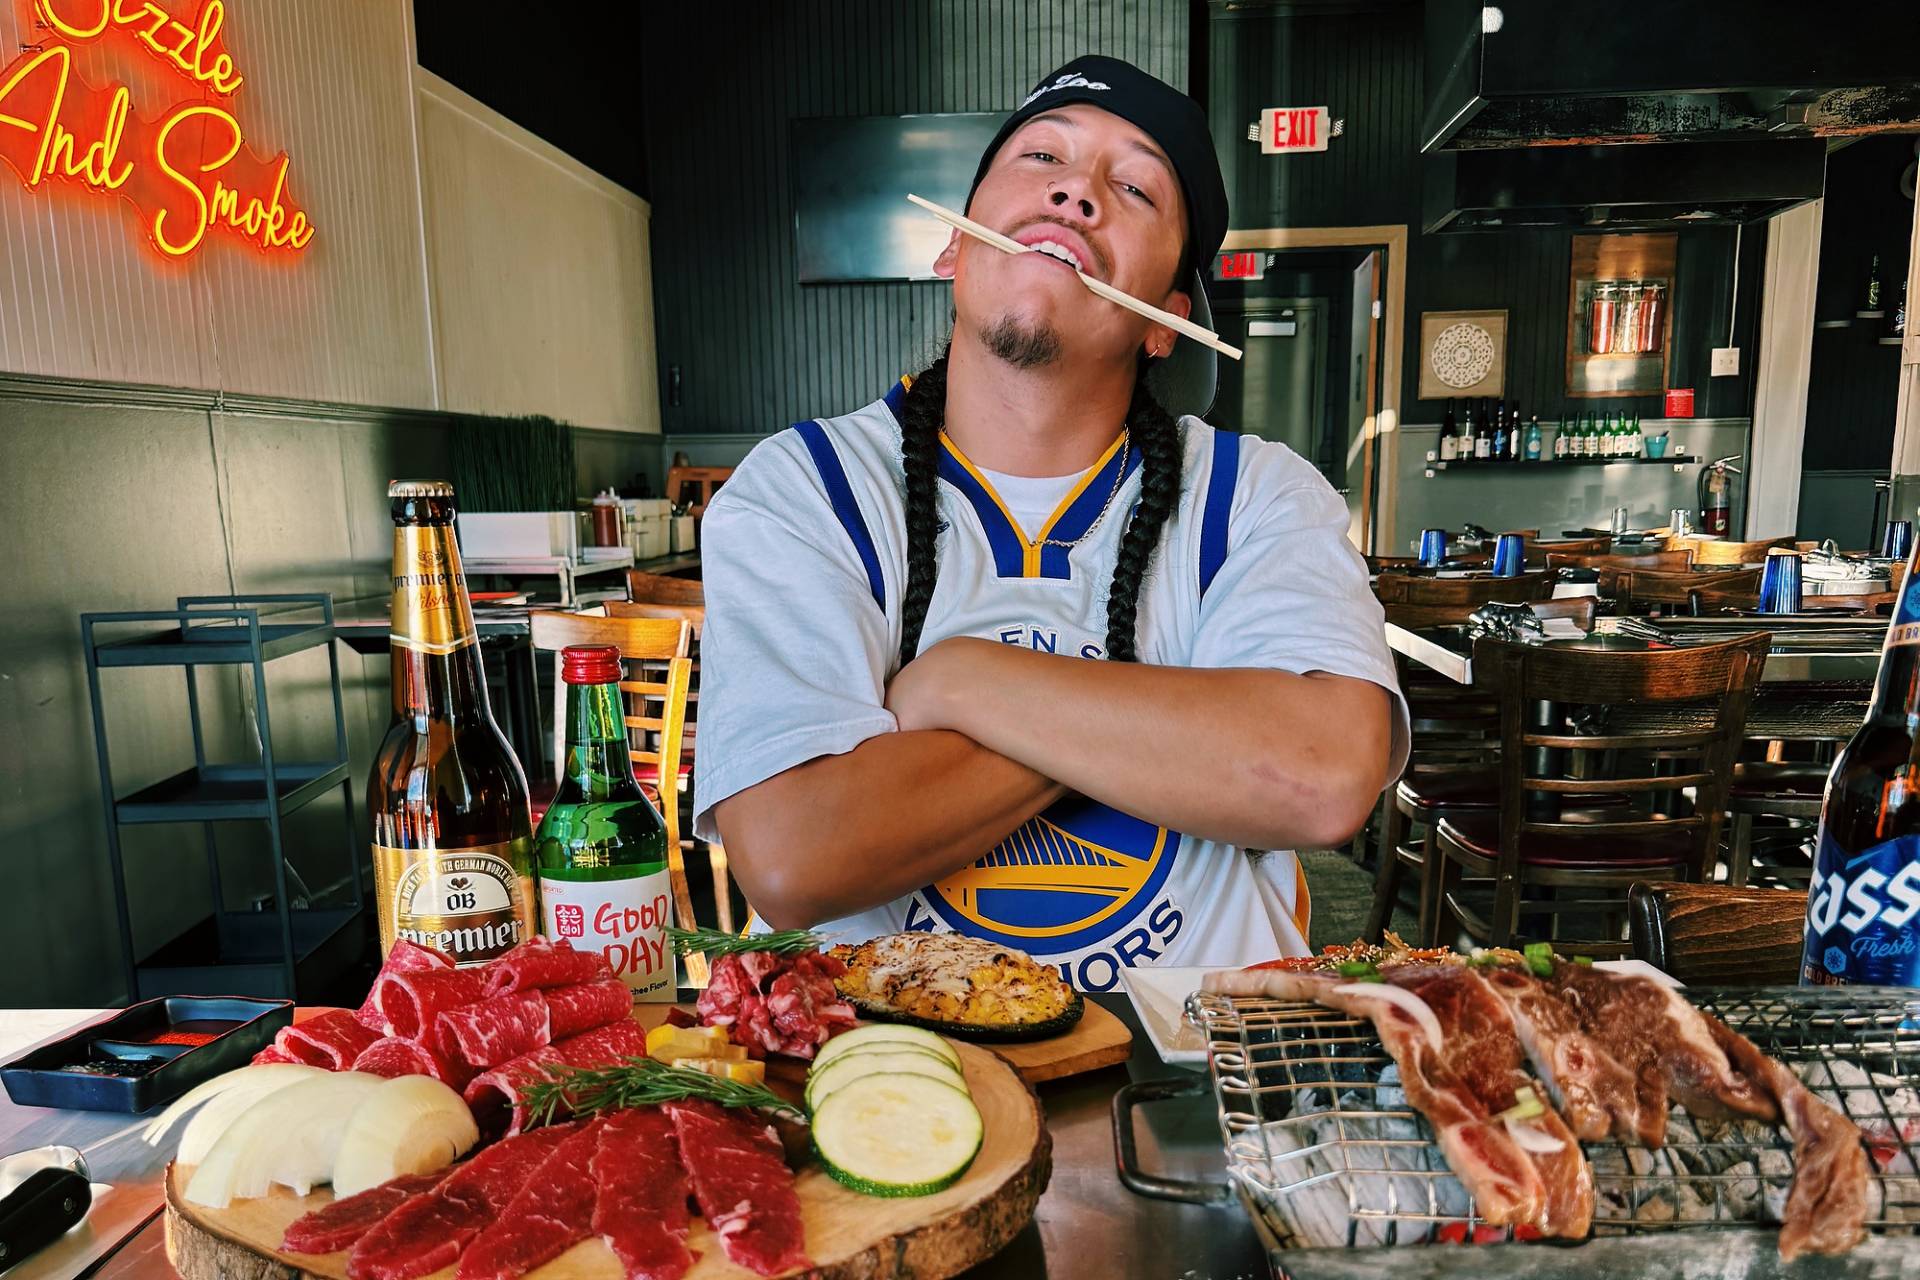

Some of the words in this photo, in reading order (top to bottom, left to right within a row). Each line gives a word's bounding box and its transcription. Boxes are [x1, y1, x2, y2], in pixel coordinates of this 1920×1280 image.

[1273, 109, 1319, 148] EXIT
[0, 45, 134, 189] And
[154, 106, 316, 256] Smoke
[437, 860, 453, 873] ITH
[454, 858, 486, 871] GERMAN
[485, 861, 508, 880] NOBLE
[446, 892, 476, 911] OB
[603, 931, 666, 977] DAY
[1849, 932, 1917, 959] Fresh
[1824, 975, 1849, 986] BRE
